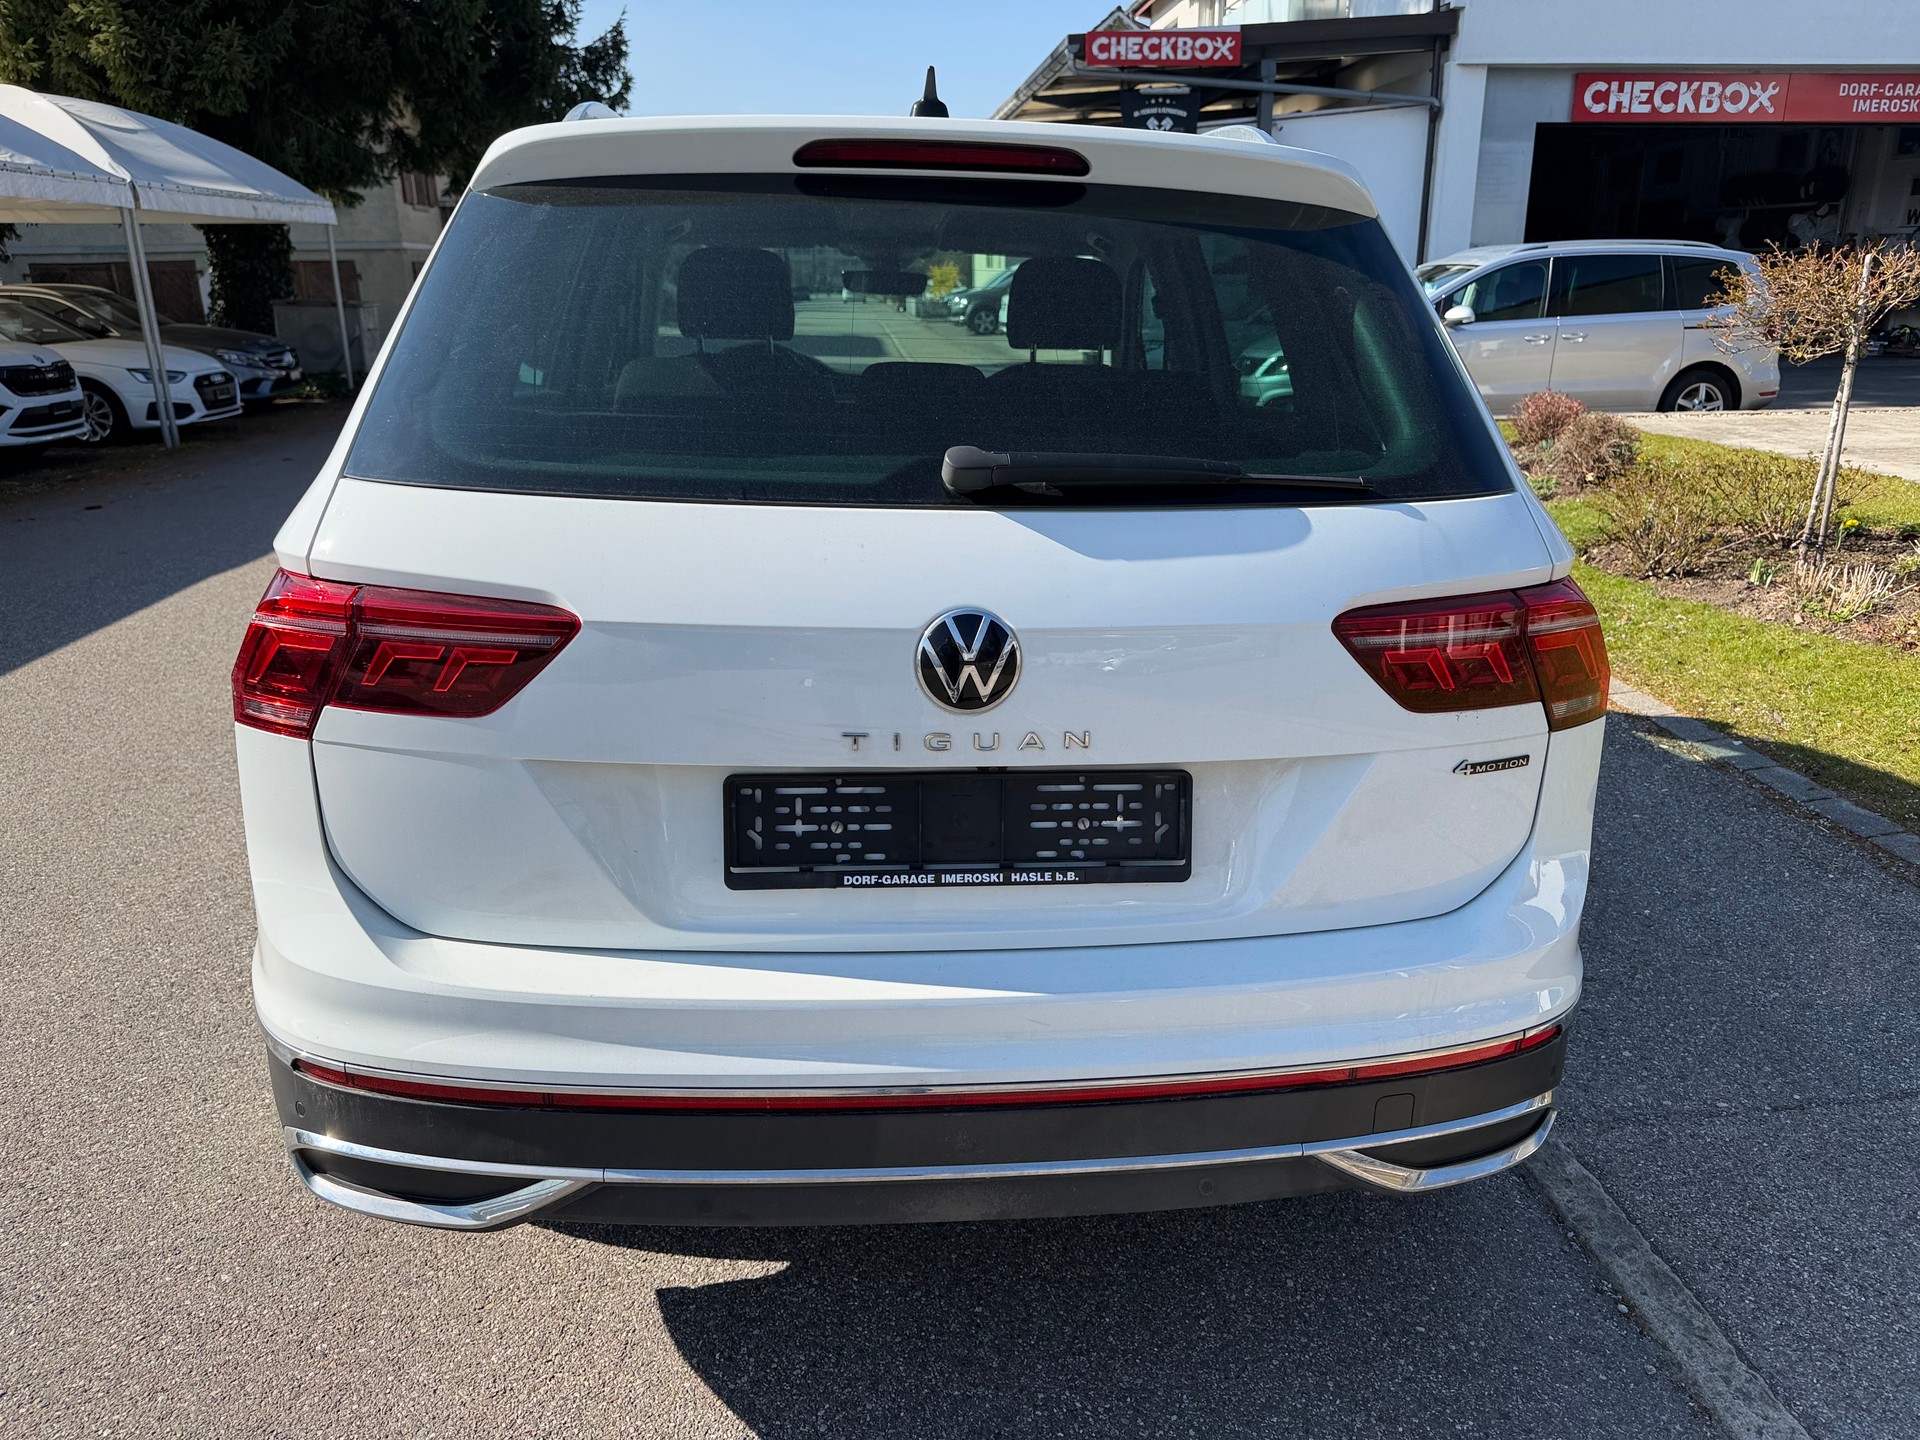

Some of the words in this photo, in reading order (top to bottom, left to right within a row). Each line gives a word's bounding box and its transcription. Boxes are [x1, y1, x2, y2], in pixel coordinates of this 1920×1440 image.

[1091, 36, 1236, 61] CHECKBOX
[1583, 81, 1780, 114] CHECKBOX
[1852, 99, 1920, 113] IMEROSK
[841, 730, 1091, 751] TIGUAN
[843, 874, 936, 886] DORF-GARAGE
[941, 873, 1004, 884] IMEROSKI
[1011, 872, 1052, 883] HASLE
[1055, 871, 1080, 882] b.B.
